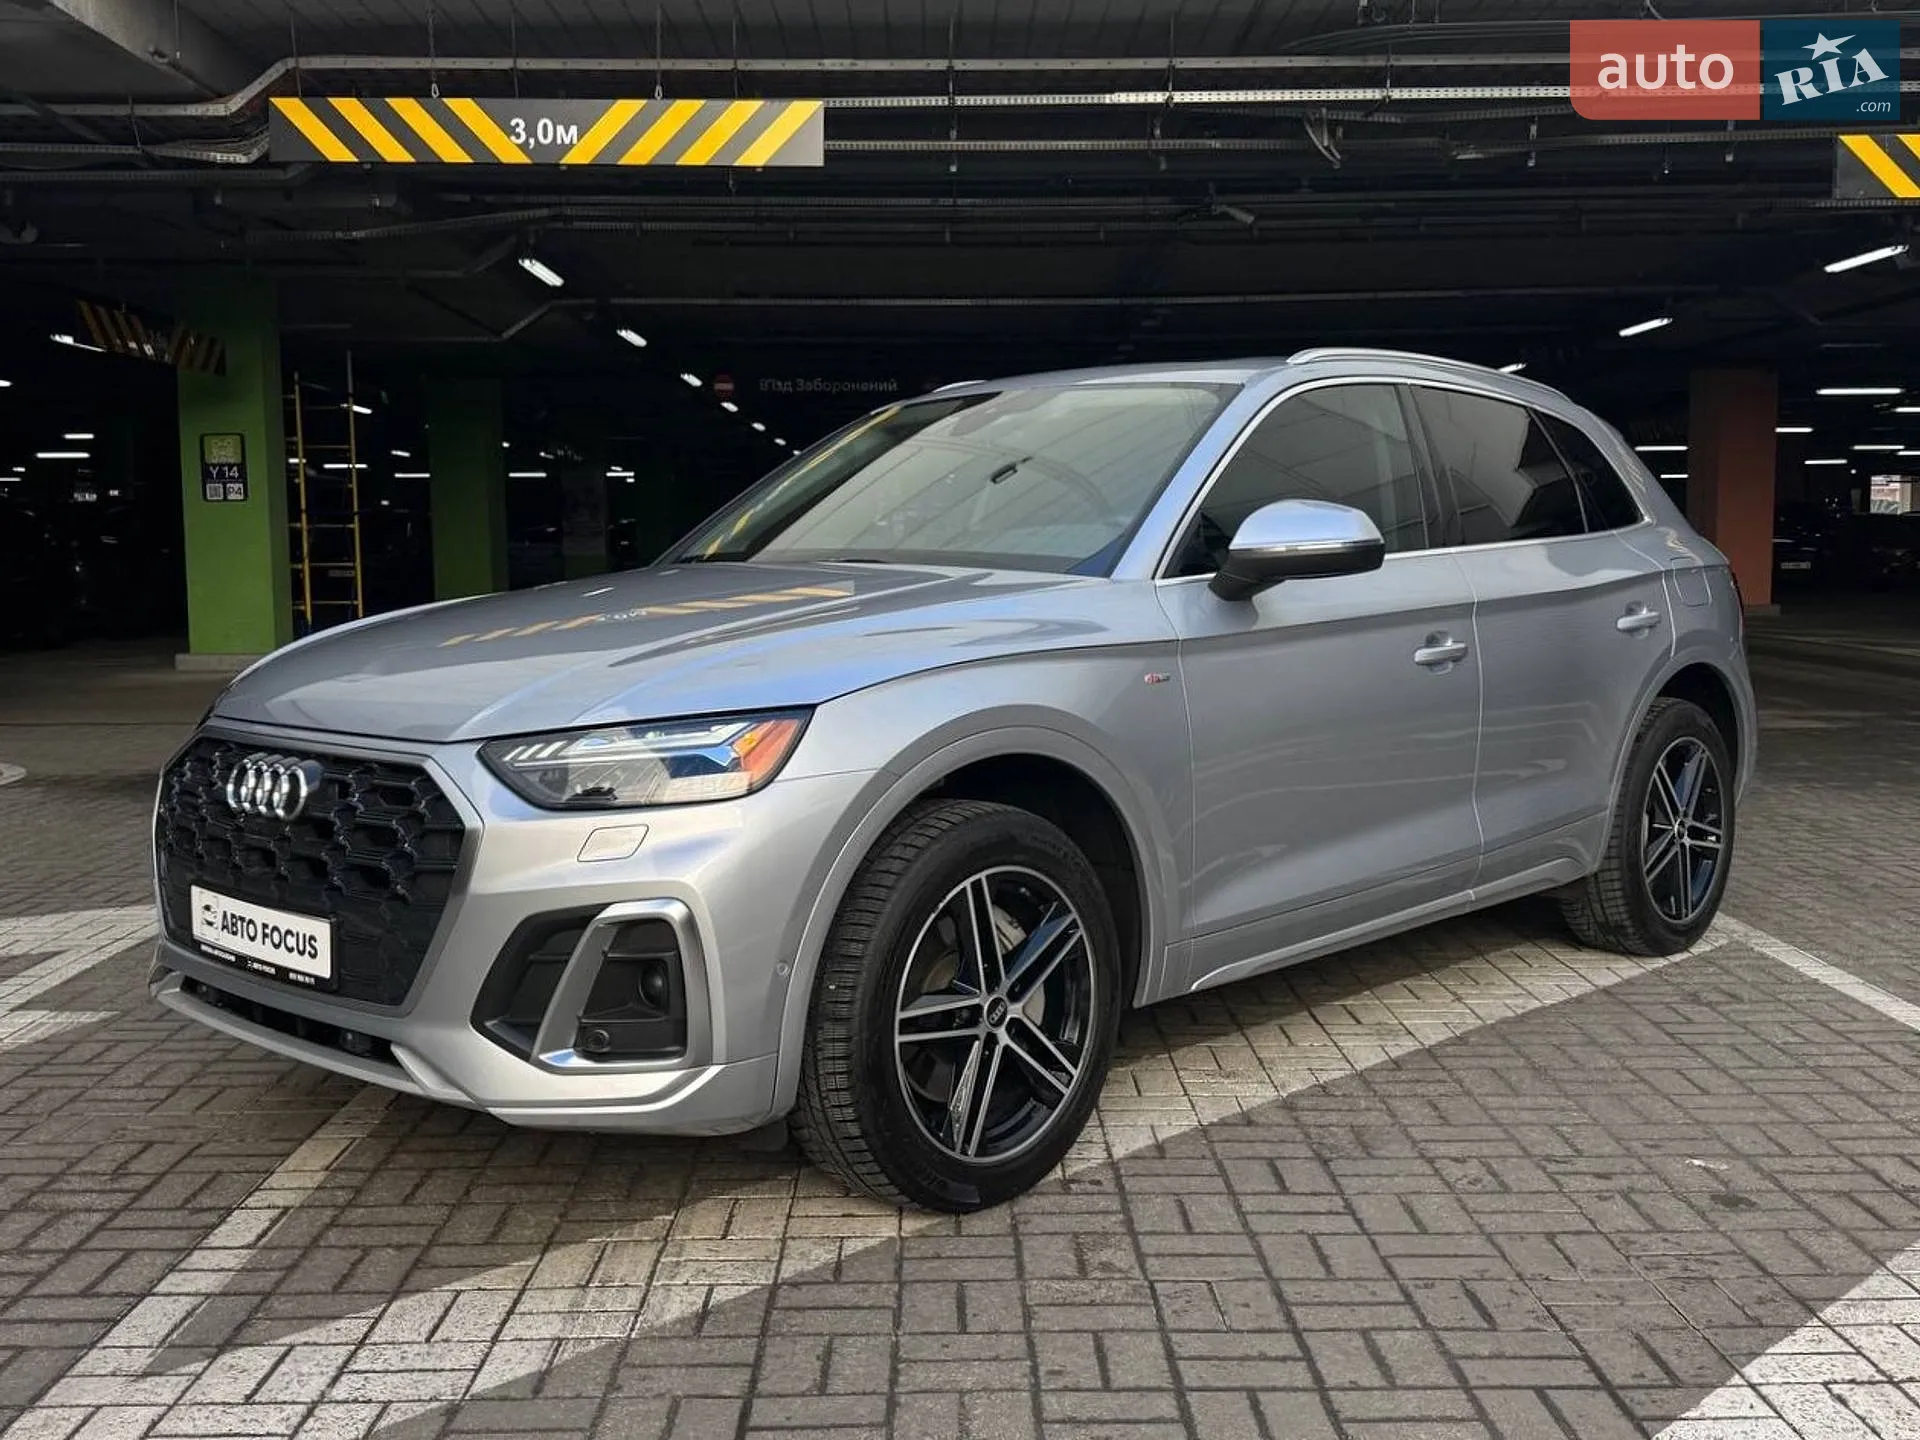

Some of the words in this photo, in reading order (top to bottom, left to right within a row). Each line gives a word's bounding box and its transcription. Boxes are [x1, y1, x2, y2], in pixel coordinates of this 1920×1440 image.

[509, 117, 578, 150] 3,0м
[209, 466, 220, 480] Y
[221, 466, 239, 479] 14
[261, 922, 319, 960] FOCUS
